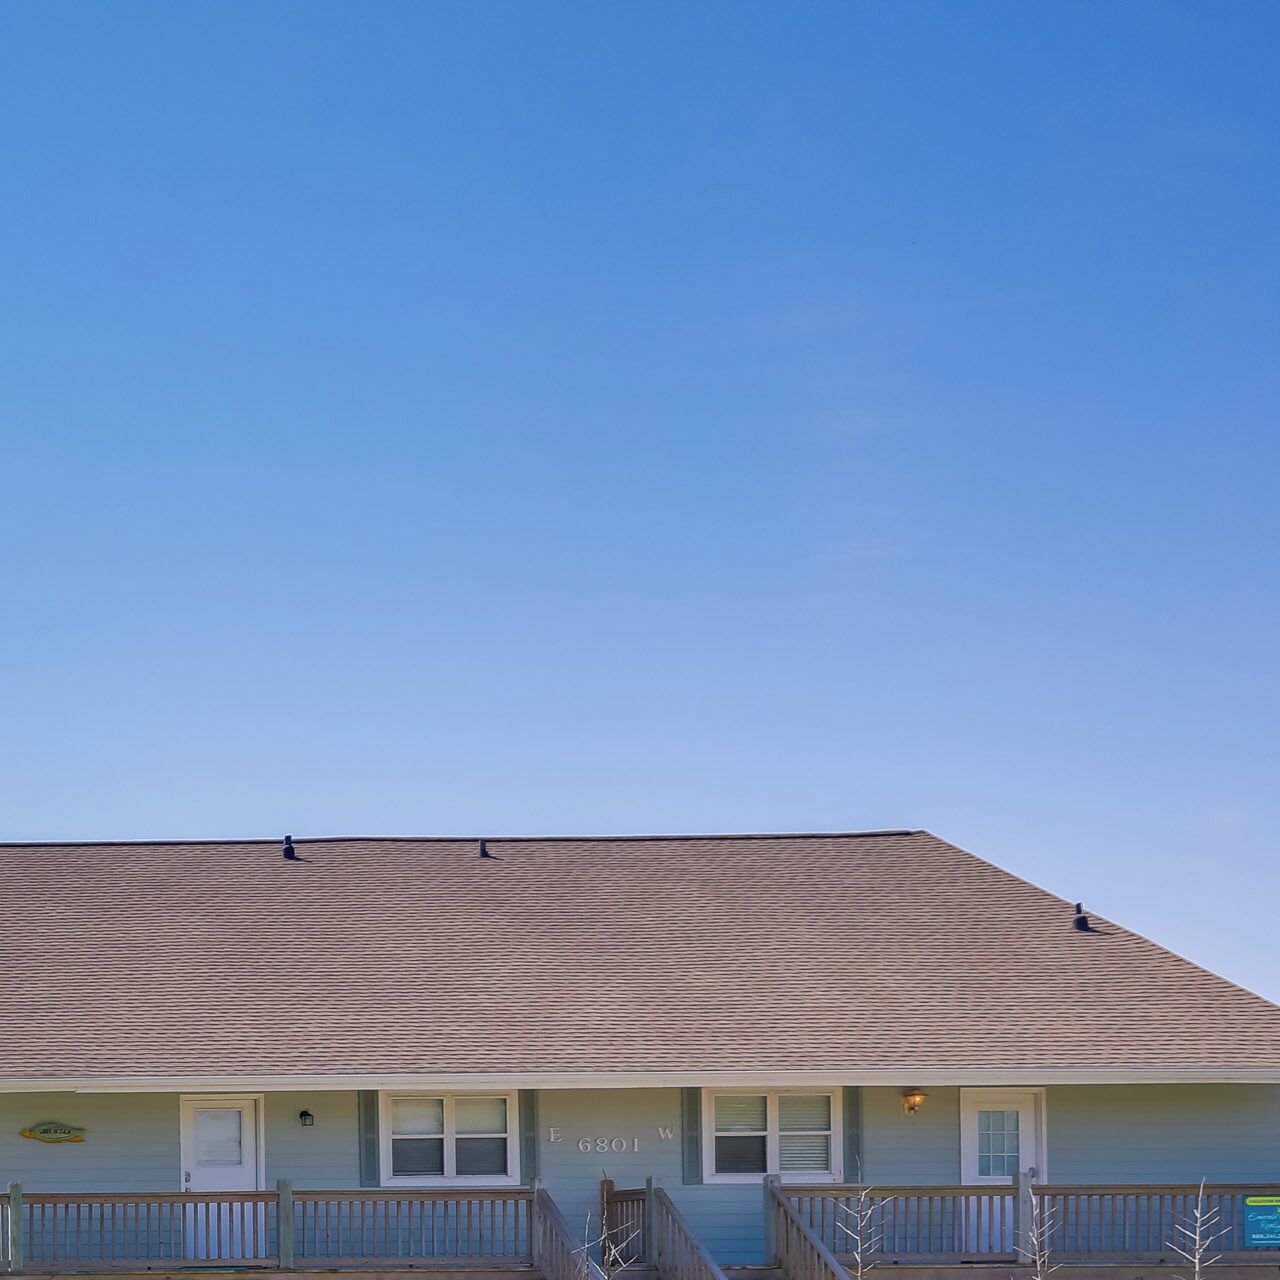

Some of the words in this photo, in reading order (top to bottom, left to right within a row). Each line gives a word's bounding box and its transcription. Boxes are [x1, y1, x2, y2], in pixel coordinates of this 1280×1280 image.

[549, 1127, 562, 1142] E
[658, 1126, 676, 1140] W
[578, 1137, 639, 1152] 6801
